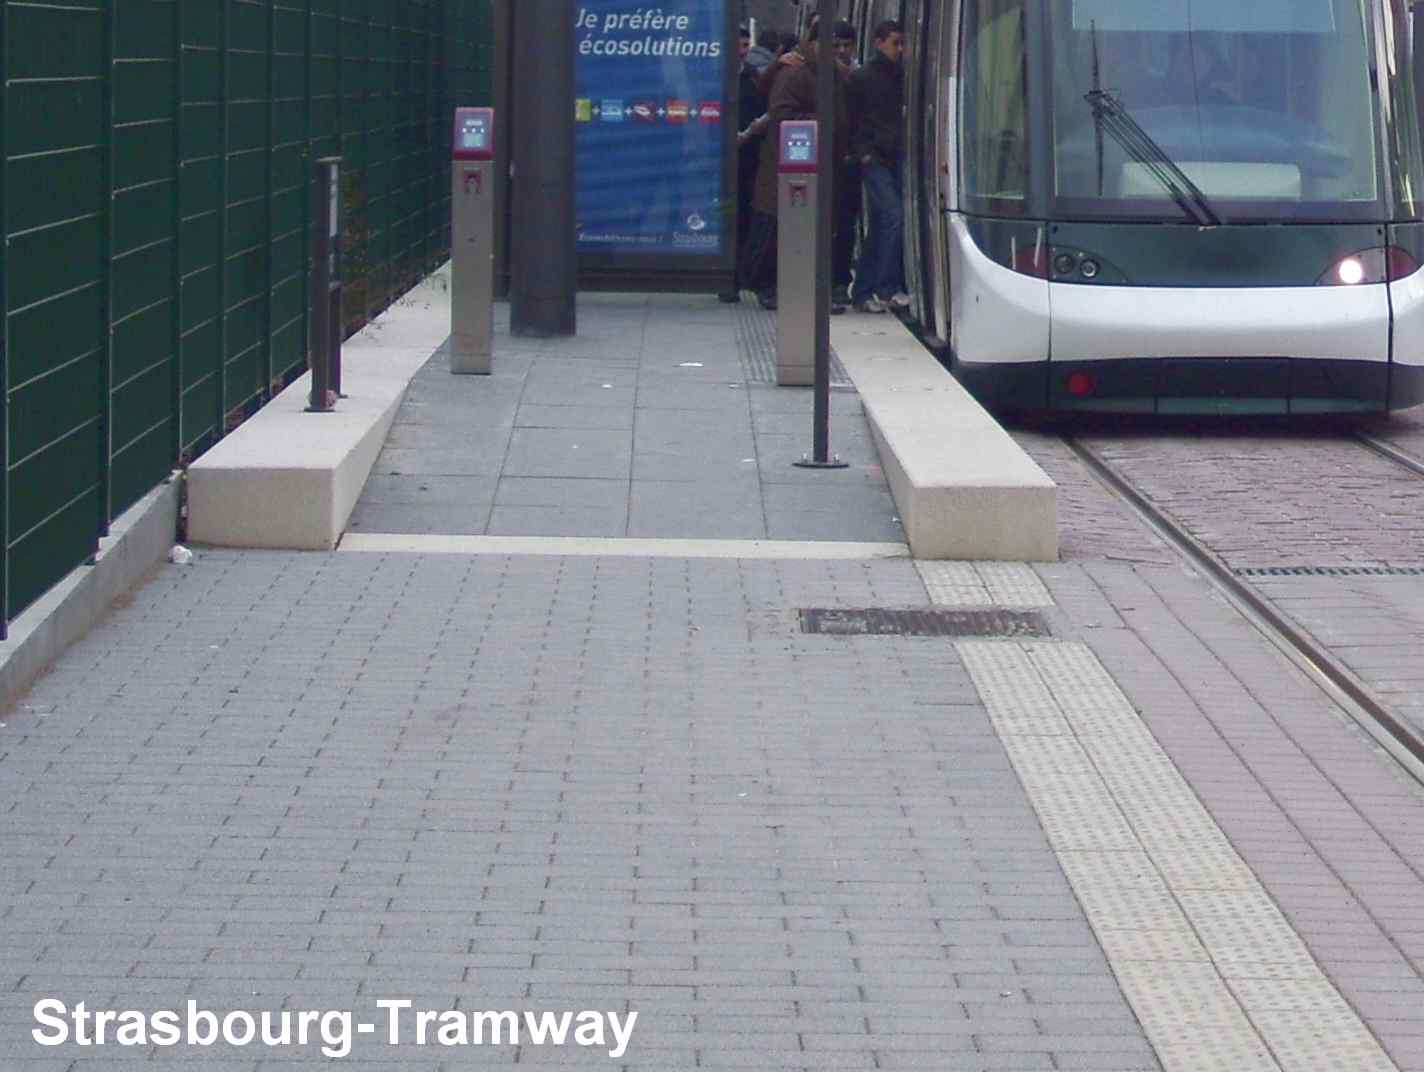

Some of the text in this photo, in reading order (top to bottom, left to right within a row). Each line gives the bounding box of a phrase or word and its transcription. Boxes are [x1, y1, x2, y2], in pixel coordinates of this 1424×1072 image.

[576, 8, 689, 34] Je préfère
[579, 33, 721, 57] écosolutions
